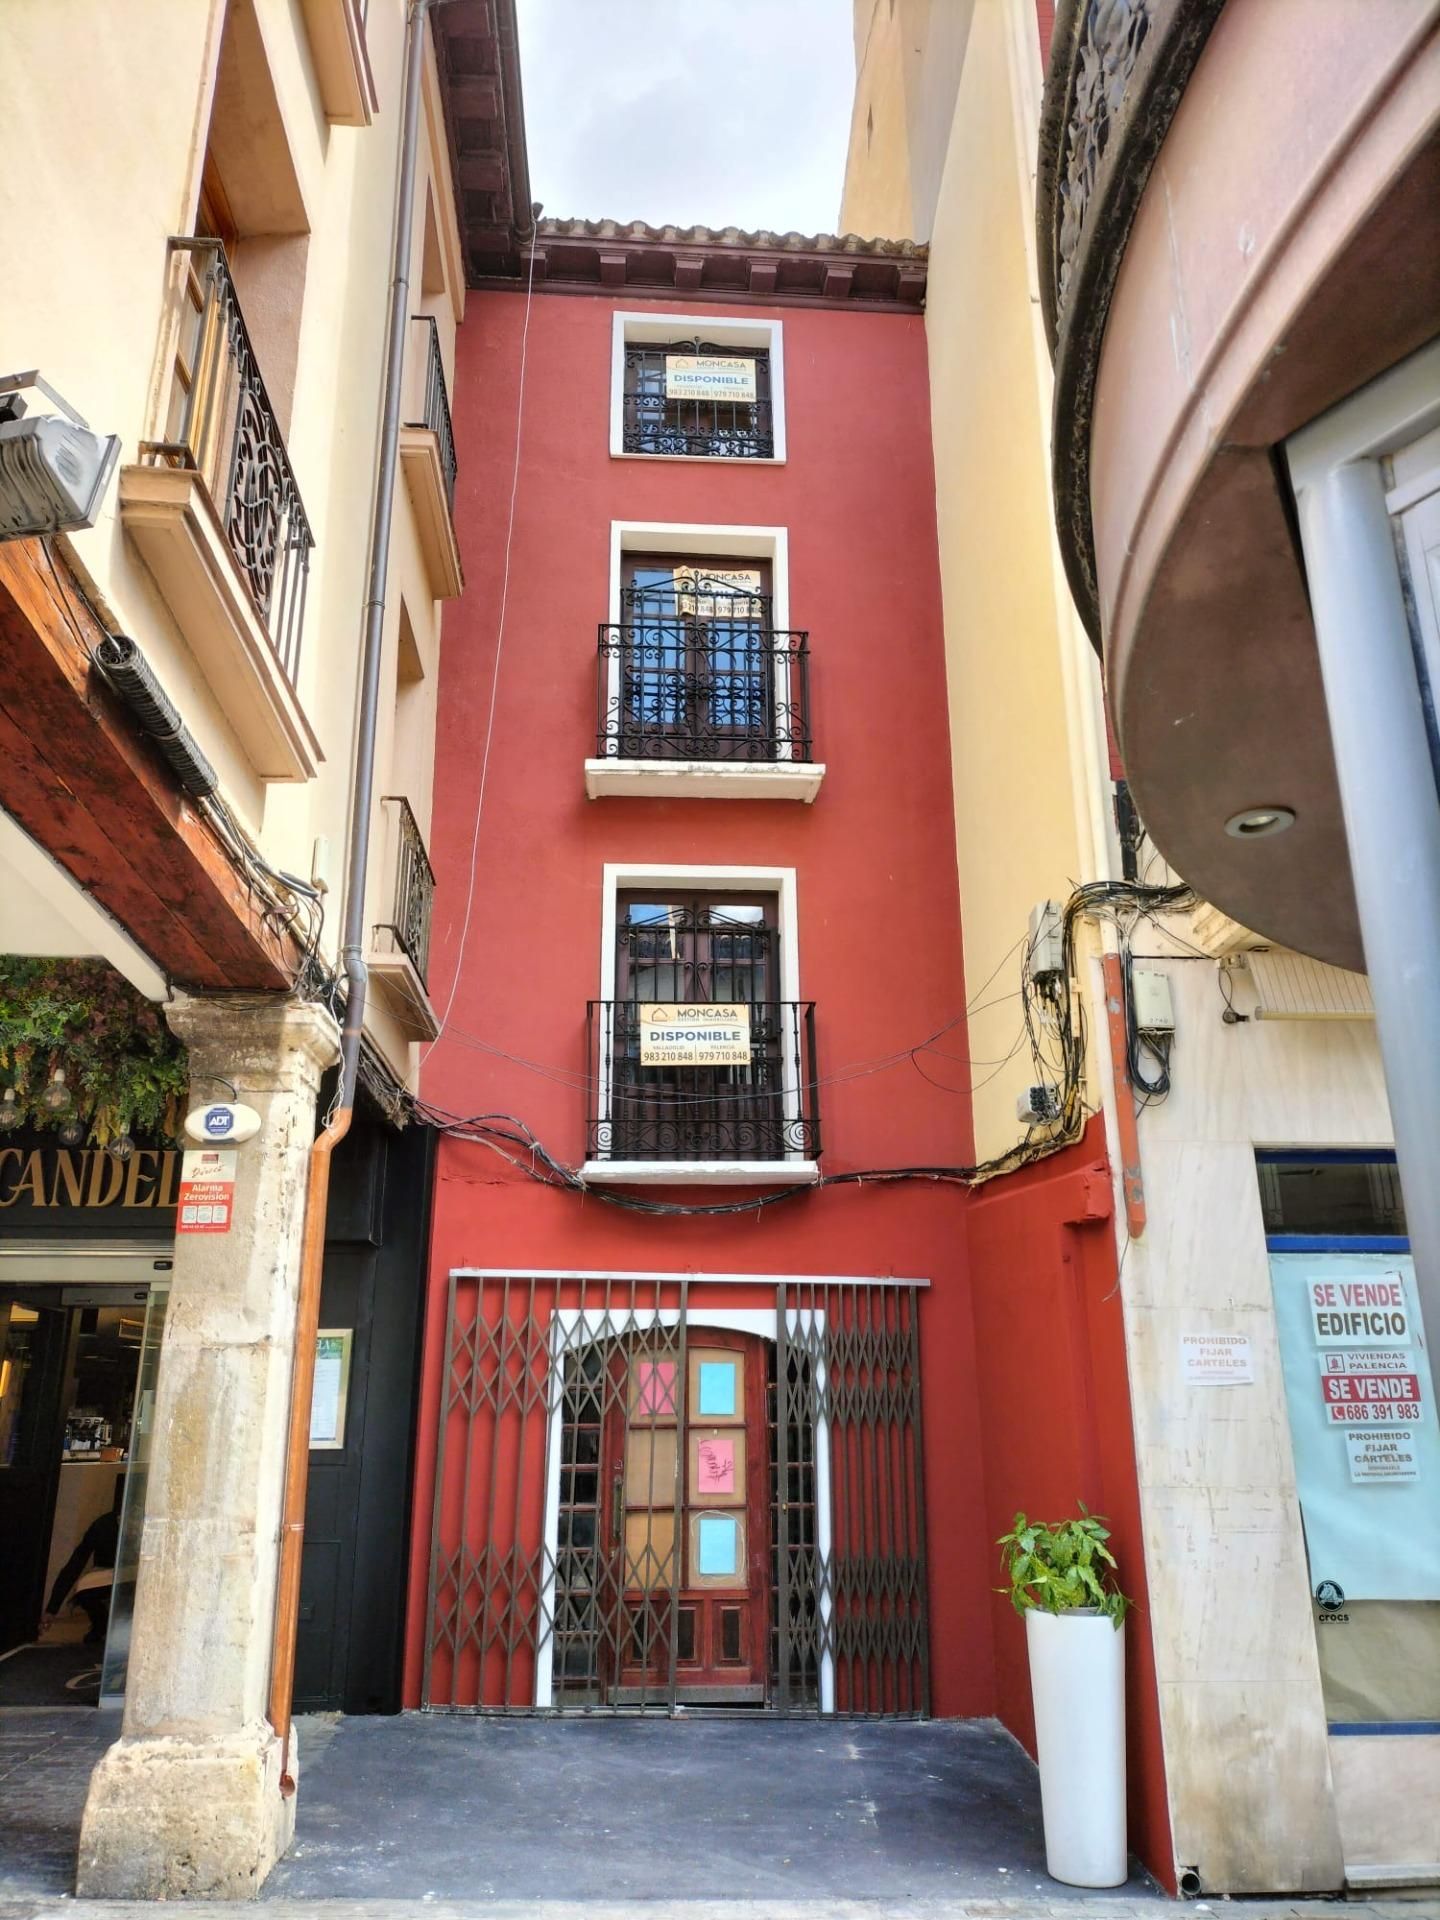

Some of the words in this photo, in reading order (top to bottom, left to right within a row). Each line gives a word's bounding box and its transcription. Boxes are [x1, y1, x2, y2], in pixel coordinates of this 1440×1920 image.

[696, 360, 746, 368] MONCASA
[674, 375, 749, 385] DISPONIBLE
[700, 573, 751, 581] MONCASA
[677, 1008, 738, 1018] MONCASA
[650, 1031, 741, 1041] DISPONIBLE
[644, 1051, 660, 1061] 983
[661, 1051, 676, 1061] 210
[677, 1051, 693, 1061] 848
[698, 1051, 714, 1061] 979
[716, 1051, 731, 1061] 710
[732, 1051, 748, 1061] 848
[208, 1115, 230, 1126] ADT
[192, 1184, 223, 1192] Alarma
[1313, 1284, 1336, 1307] SE
[1339, 1284, 1402, 1307] VENDE
[1316, 1312, 1406, 1336] EDIFICIO
[1183, 1336, 1247, 1345] PROHIBIDO
[1200, 1348, 1232, 1356] FIJAR
[1347, 1352, 1406, 1360] VIVIENDAS
[1188, 1359, 1248, 1367] CARTELES
[1328, 1379, 1352, 1400] SE
[1354, 1378, 1414, 1399] VENDE
[1346, 1404, 1369, 1420] 686
[1371, 1404, 1393, 1420] 391
[1396, 1403, 1420, 1420] 983
[1348, 1432, 1411, 1441] PROHIBIDO
[1365, 1444, 1398, 1452] FIJAR
[1354, 1454, 1413, 1463] CARTELES
